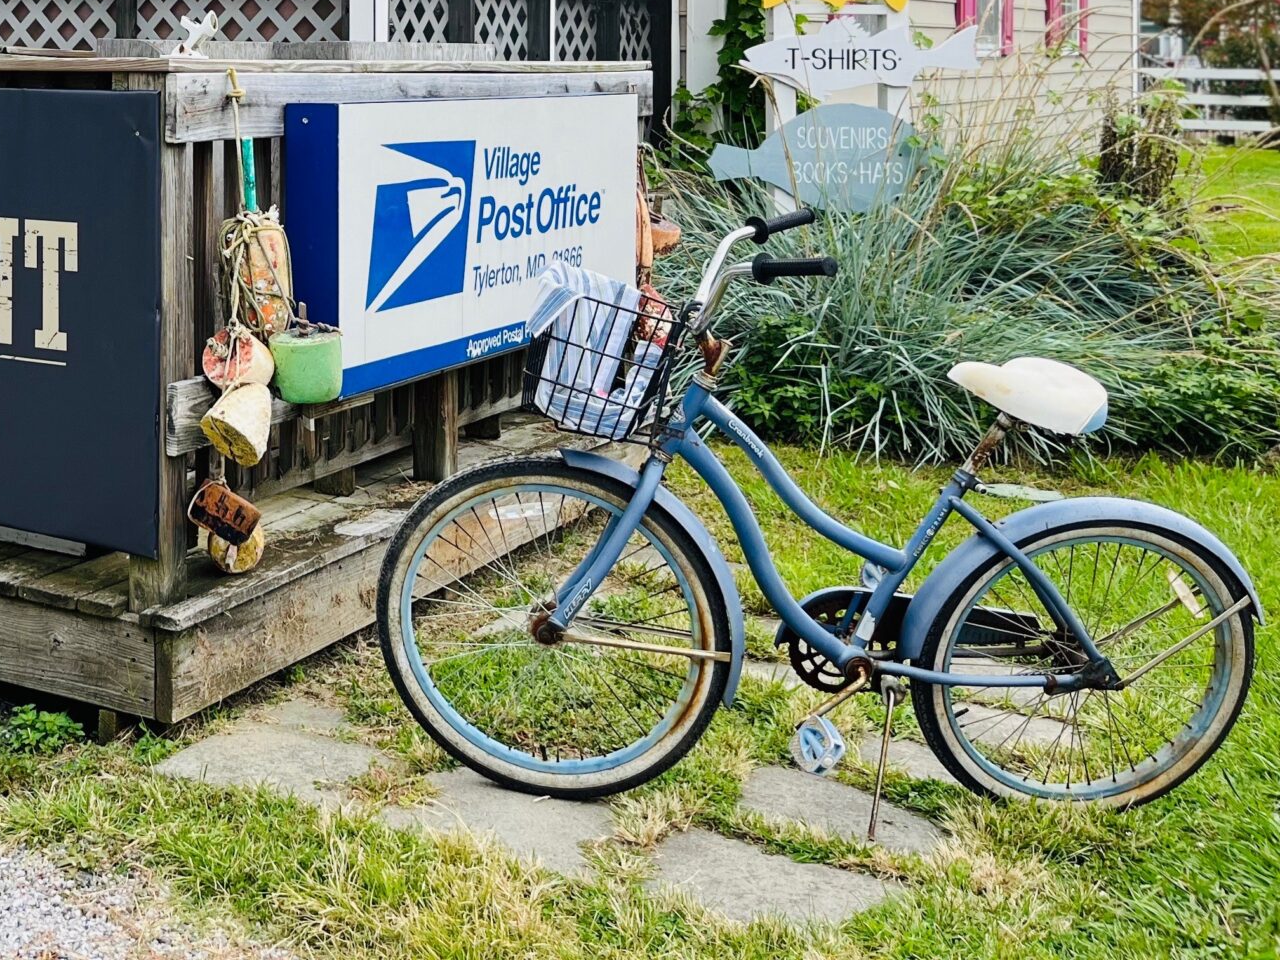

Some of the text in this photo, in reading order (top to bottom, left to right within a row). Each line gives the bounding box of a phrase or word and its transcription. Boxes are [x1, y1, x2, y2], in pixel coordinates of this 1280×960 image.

[786, 48, 898, 71] T-SHIRTS
[796, 126, 888, 150] SOUVENIRS
[483, 146, 541, 186] Village
[472, 262, 523, 297] Tylerton,
[465, 331, 502, 358] Approved
[502, 325, 524, 344] Postal
[727, 419, 764, 459] Cranbrook
[563, 577, 592, 620] HUFFY
